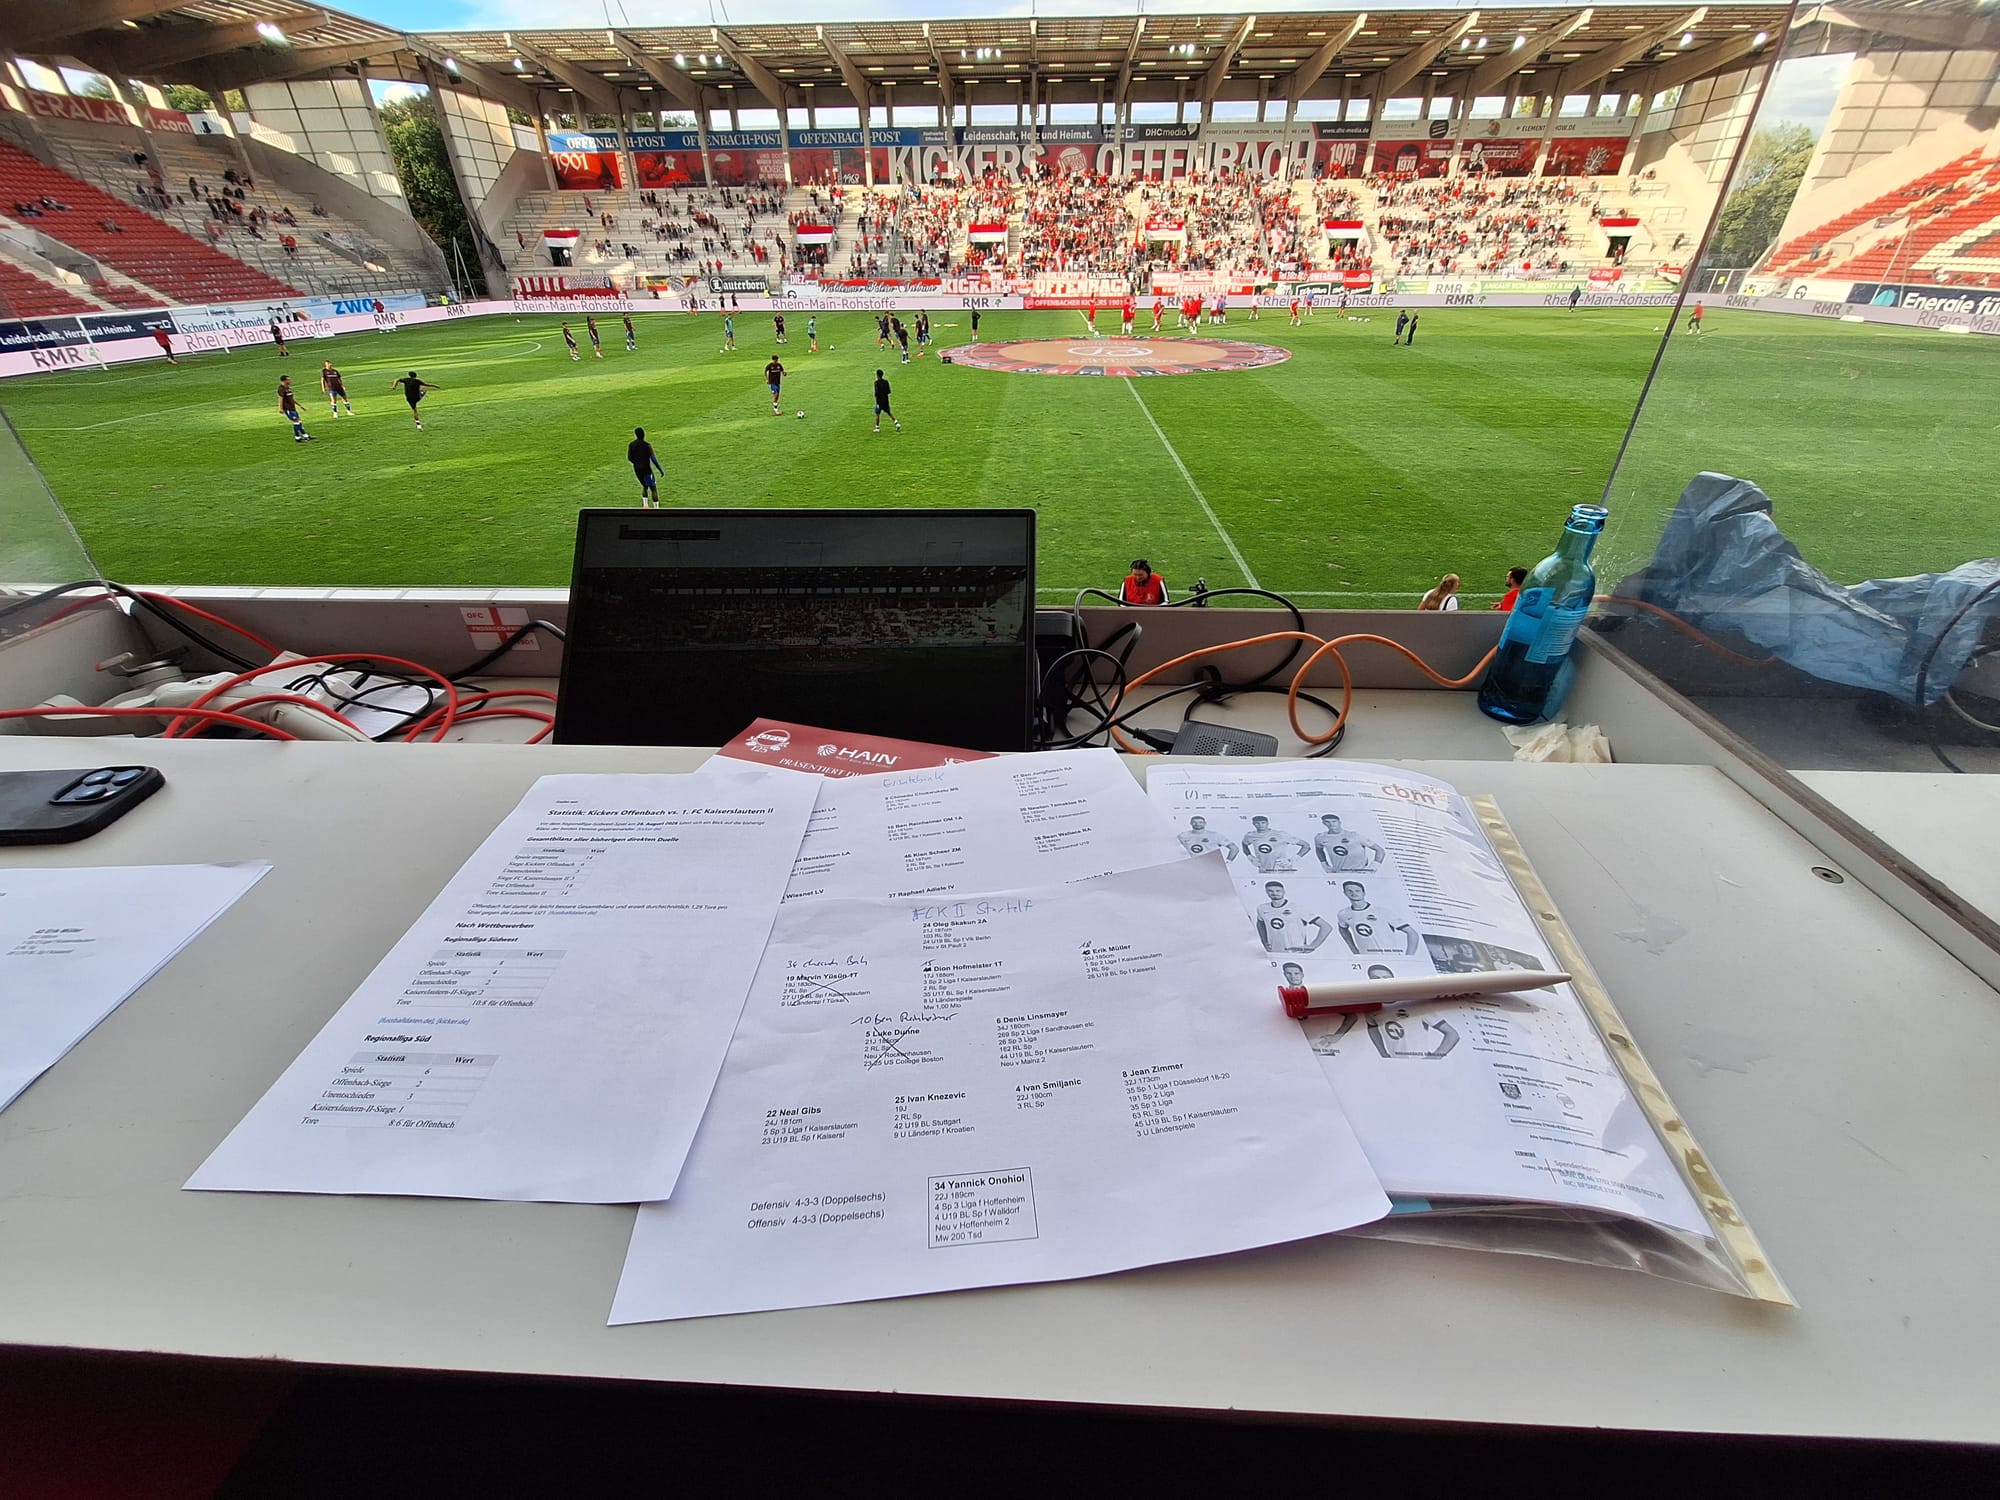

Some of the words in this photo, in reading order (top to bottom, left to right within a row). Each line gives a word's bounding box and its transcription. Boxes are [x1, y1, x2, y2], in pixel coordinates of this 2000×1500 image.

[963, 128, 1020, 142] Leidenschaft,
[1042, 129, 1058, 140] und
[1060, 130, 1093, 140] Heimat.
[1145, 128, 1187, 136] DHCmedia
[567, 135, 666, 150] OFFENBAH-POST
[552, 153, 589, 174] 1901
[889, 145, 1046, 184] KICKERS
[1097, 140, 1318, 182] OFFENBACH
[1396, 157, 1416, 172] 1974
[790, 274, 806, 285] DIEZ
[1435, 284, 1462, 294] RMR
[772, 298, 896, 310] Rhein-Main-Rohstoffe
[962, 298, 990, 308] RMR
[1446, 294, 1474, 304] RMR
[1726, 296, 1748, 307] RMR
[1902, 292, 1972, 314] Energie
[447, 304, 464, 317] RMR
[514, 301, 634, 312] Rhein-Main-Rohstoffe
[1812, 303, 1840, 316] RMR
[374, 313, 398, 326] RMR
[104, 322, 136, 334] Heimat.
[184, 320, 331, 350] Rhein-Main-ohstoffe
[31, 347, 84, 368] RMR
[838, 747, 899, 766] HAIN
[778, 757, 846, 777] PRÄSENTIERT
[1380, 784, 1436, 805] cbm
[952, 962, 993, 970] Hofmeister
[1352, 963, 1362, 971] 21
[1003, 1014, 1026, 1023] Denis
[1027, 1010, 1068, 1022] Linsmayer
[364, 1034, 414, 1043] Regionalliga
[1122, 1069, 1129, 1078] 8
[1128, 1066, 1150, 1077] Jean
[1151, 1062, 1183, 1073] Zimmer
[1016, 1084, 1021, 1092] 4
[1023, 1082, 1041, 1091] Ivan
[1042, 1077, 1082, 1091] Smiljanic
[895, 1095, 905, 1104] 25
[907, 1094, 926, 1103] Ivan
[927, 1090, 966, 1101] Knezevic
[766, 1108, 777, 1117] 22
[779, 1107, 799, 1116] Neal
[801, 1105, 822, 1114] Gibs
[414, 1120, 455, 1128] Offenbach
[935, 1181, 947, 1190] 34
[946, 1177, 987, 1189] Yannick
[988, 1174, 1025, 1185] Onohiol
[935, 1192, 950, 1200] 22J
[949, 1190, 975, 1199] 189cm
[750, 1200, 790, 1212] Defensiv
[795, 1197, 819, 1207] 4-3-3
[822, 1192, 886, 1207] (Doppelsechs)
[748, 1217, 786, 1229] Offensiv
[792, 1214, 817, 1224] 4-3-3
[819, 1210, 885, 1225] (Doppelsechs)
[935, 1223, 951, 1231] Neu
[959, 1218, 1003, 1229] Hoffenheim
[935, 1234, 950, 1242] Mw
[950, 1232, 966, 1241] 200
[967, 1231, 982, 1239] Tsd
